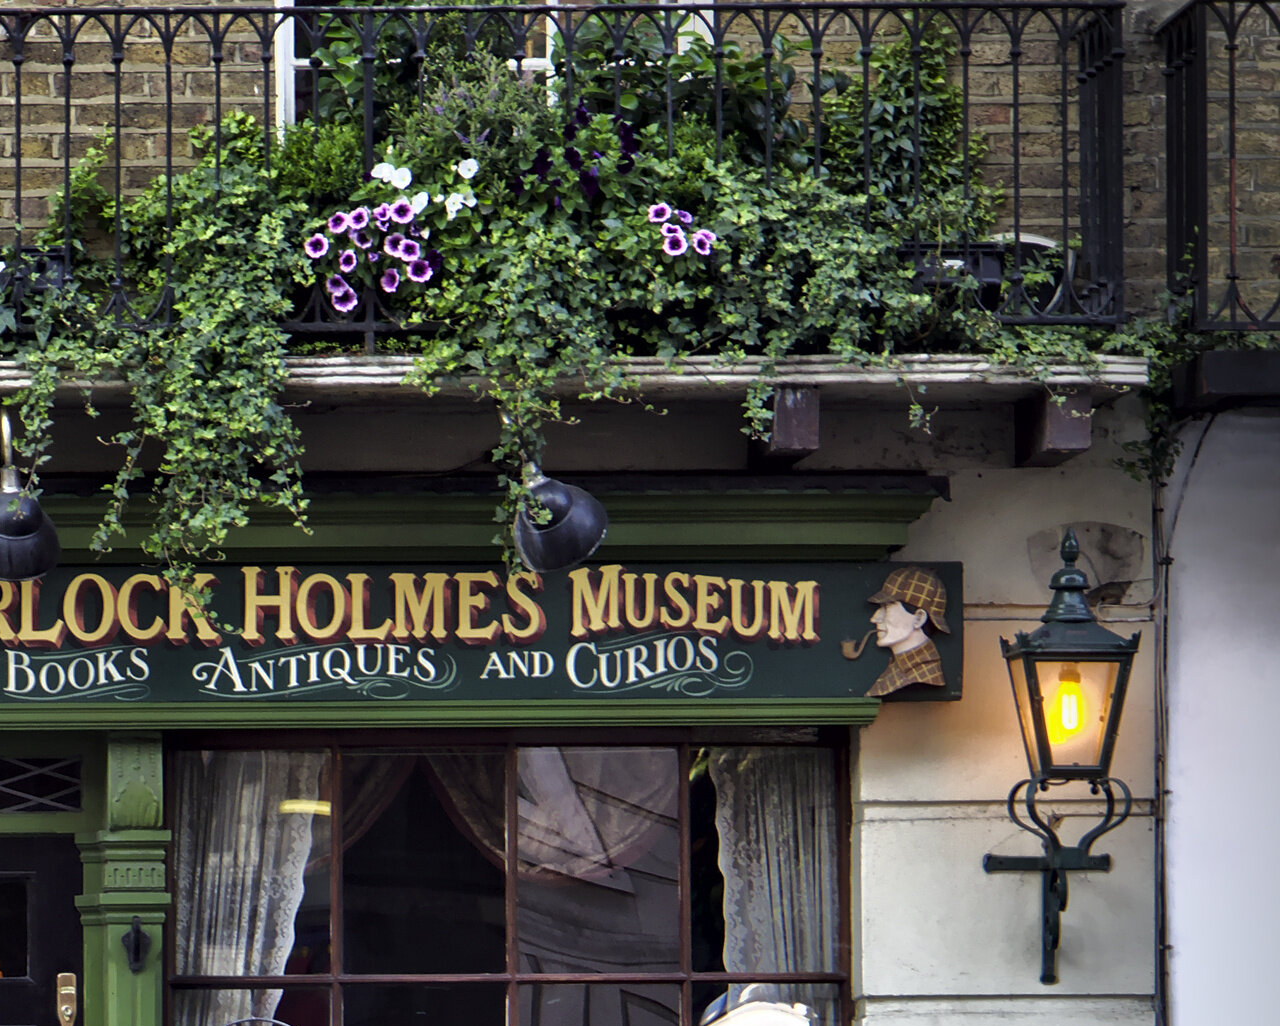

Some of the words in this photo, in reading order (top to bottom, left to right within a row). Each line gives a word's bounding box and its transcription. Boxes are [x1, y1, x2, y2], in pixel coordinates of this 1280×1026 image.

[241, 565, 547, 647] HOLMES
[568, 564, 820, 645] MUSEUM
[3, 647, 150, 694] BOOKS
[192, 643, 437, 692] ANTIQUES
[480, 650, 555, 679] AND
[566, 636, 719, 688] CURIOS
